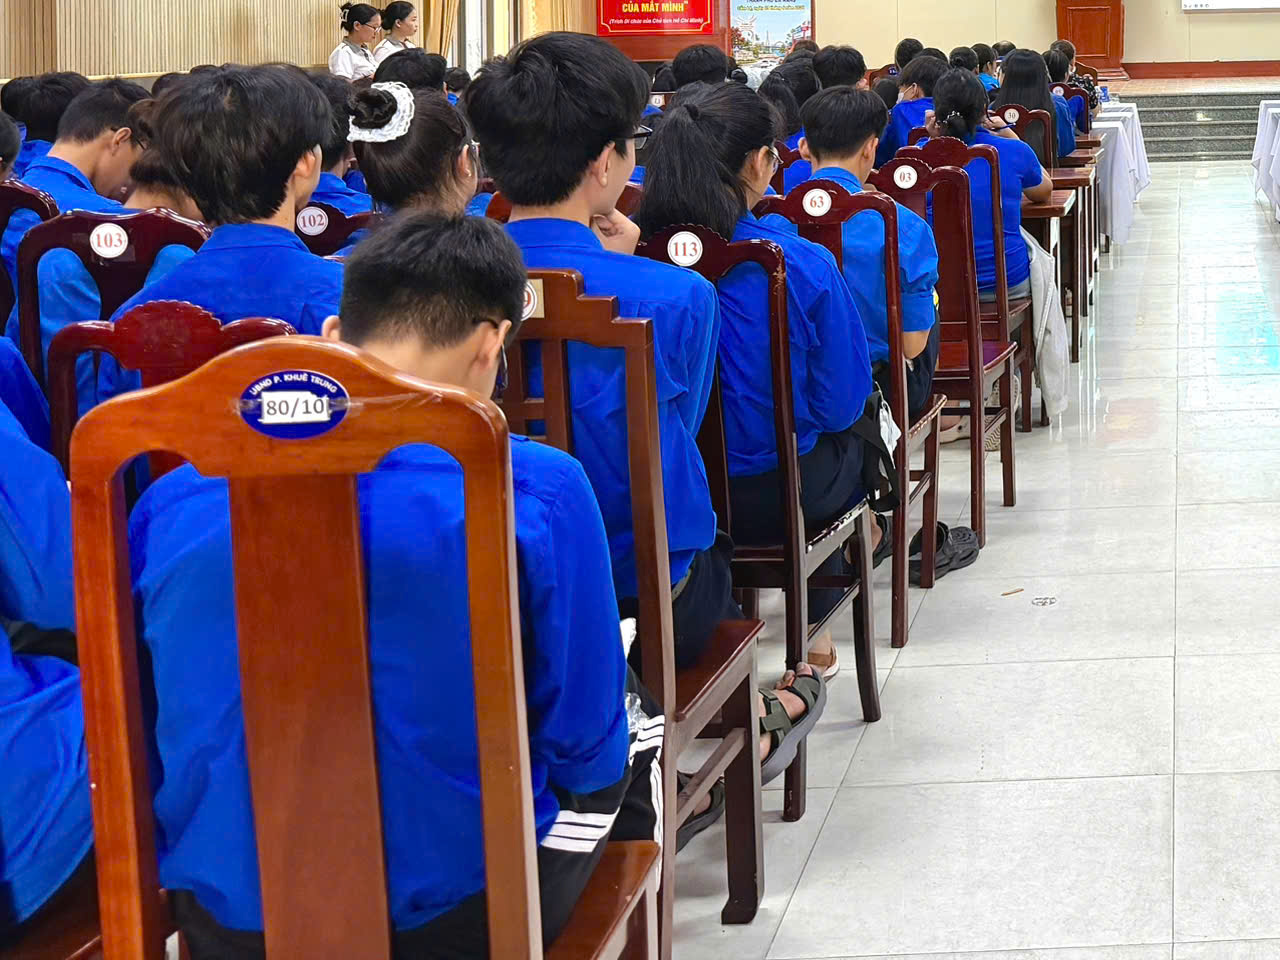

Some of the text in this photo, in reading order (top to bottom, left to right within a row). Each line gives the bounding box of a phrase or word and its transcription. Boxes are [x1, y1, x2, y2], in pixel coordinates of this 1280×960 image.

[900, 172, 912, 183] 03
[810, 195, 824, 208] 63
[301, 214, 325, 228] 102
[95, 232, 123, 249] 103
[673, 242, 698, 257] 113
[249, 373, 337, 395] UBND P. KHUÊ TRUNG
[266, 398, 324, 418] 80/10
